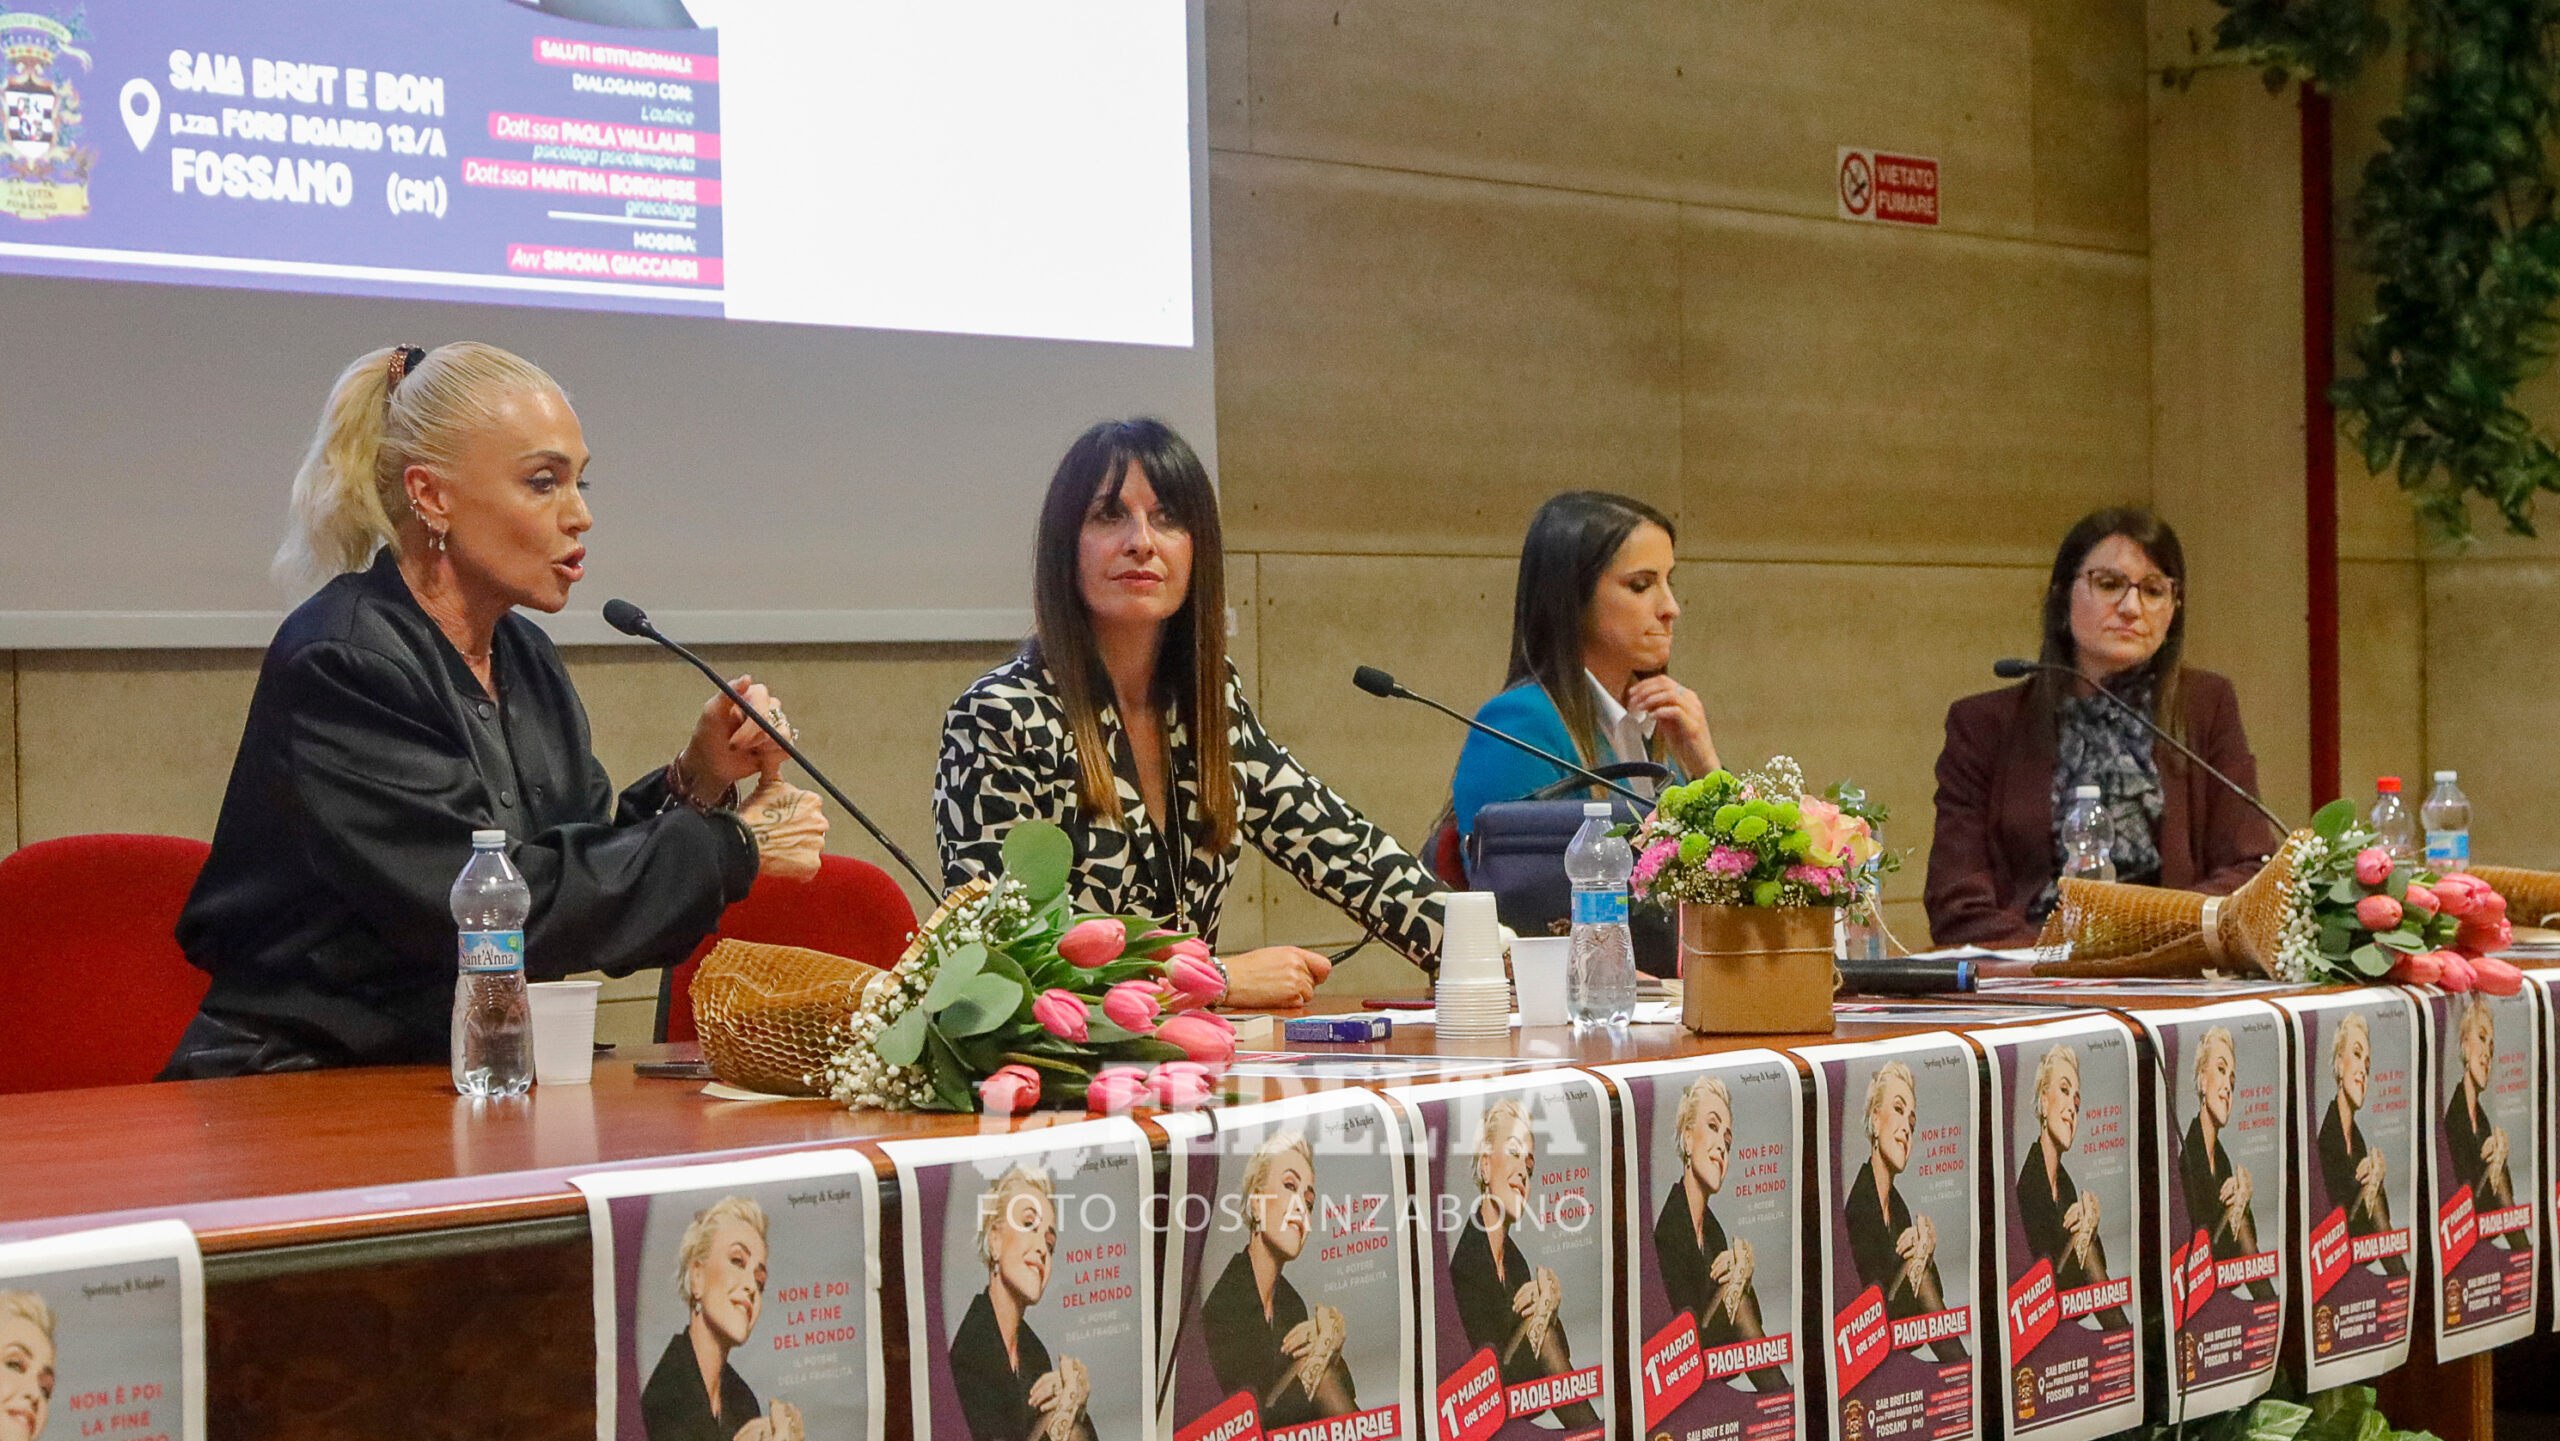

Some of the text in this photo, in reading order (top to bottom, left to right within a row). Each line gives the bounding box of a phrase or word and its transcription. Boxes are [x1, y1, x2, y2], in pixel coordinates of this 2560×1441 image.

[540, 41, 590, 62] SALUTI
[345, 68, 368, 109] E
[572, 73, 656, 98] DIALOGANO
[386, 123, 447, 158] 13/A
[561, 122, 616, 146] PAOLA
[617, 127, 695, 153] VALLAURI
[533, 144, 696, 172] psicologa psicoterapeuta
[171, 147, 353, 208] FOSSANO
[531, 167, 607, 193] MARTINA
[609, 174, 697, 200] BORGHESE
[1876, 163, 1935, 190] VIETATO
[625, 199, 697, 222] ginecologa
[1878, 190, 1936, 215] FUMARE
[542, 250, 609, 273] SIMONA
[611, 255, 698, 279] GIACCARDI
[2086, 1109, 2102, 1120] NON
[2110, 1105, 2122, 1116] POI
[1922, 1131, 1939, 1142] NON
[1948, 1126, 1962, 1137] POI
[2091, 1122, 2118, 1136] LA FINE
[1739, 1149, 1758, 1160] NON
[1769, 1144, 1783, 1155] POI
[1927, 1143, 1957, 1158] LA FINE
[2084, 1137, 2125, 1154] DEL MONDO
[1542, 1172, 1562, 1185] NON
[1574, 1167, 1590, 1180] POI
[1745, 1162, 1778, 1178] LA FINE
[1919, 1159, 1964, 1176] DEL MONDO
[1549, 1187, 1585, 1204] LA FINE
[1736, 1179, 1786, 1197] DEL MONDO
[1326, 1206, 1347, 1220] NON
[1363, 1197, 1381, 1211] POI
[1539, 1204, 1594, 1224] DEL MONDO
[1332, 1218, 1376, 1239] LA FINE
[1067, 1250, 1093, 1264] NON
[1107, 1243, 1127, 1257] POI
[1321, 1235, 1388, 1262] DEL MONDO
[1075, 1266, 1120, 1285] LA FINE
[2217, 1254, 2276, 1285] PAOLA BARALE
[778, 1286, 808, 1303] NON
[826, 1281, 850, 1297] POI
[1063, 1285, 1132, 1308] DEL MONDO
[2023, 1273, 2052, 1307] MARZO
[2062, 1280, 2128, 1315] PAOLA BARALE
[788, 1305, 842, 1325] LA FINE
[1850, 1301, 1883, 1336] MARZO
[774, 1327, 856, 1350] DEL MONDO
[1893, 1310, 1967, 1346] PAOLA BARALE
[1660, 1328, 1695, 1366] MARZO
[1708, 1338, 1788, 1375] PAOLA BARALE
[70, 1391, 108, 1410] NON
[131, 1382, 163, 1401] POI
[1458, 1365, 1496, 1406] MARZO
[1511, 1370, 1598, 1414] PAOLA BARALE
[1464, 1391, 1500, 1428] ORE 20:45
[81, 1410, 150, 1436] LA FINE
[1202, 1409, 1254, 1441] MARZO
[1330, 1410, 1393, 1441] BARALE
[1876, 1419, 1907, 1438] FOSSANO
